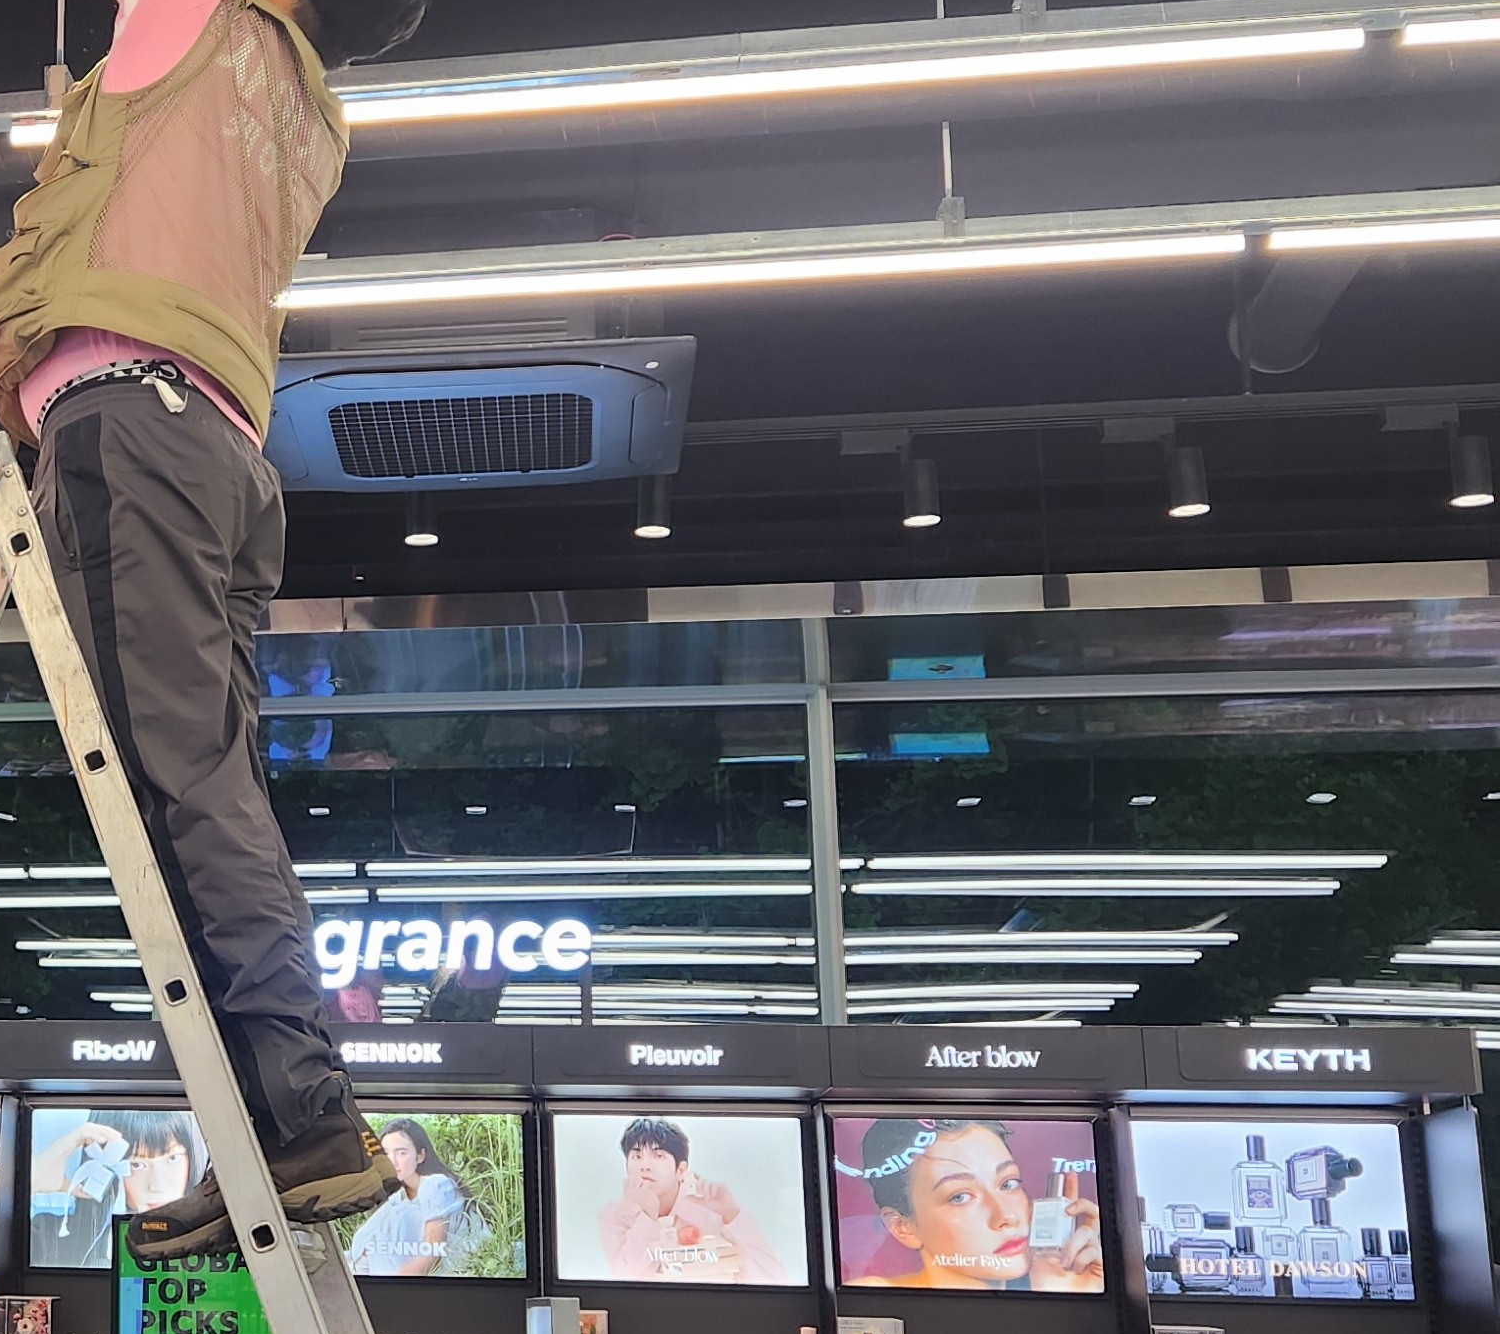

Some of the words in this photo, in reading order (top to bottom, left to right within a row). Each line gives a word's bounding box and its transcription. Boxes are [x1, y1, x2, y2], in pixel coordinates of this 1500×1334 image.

[315, 918, 592, 990] grance
[72, 1040, 157, 1063] RboW
[341, 1042, 443, 1063] SENNOK
[629, 1044, 724, 1067] Pleuvoir
[925, 1045, 982, 1068] After
[984, 1045, 1041, 1068] blow
[1247, 1048, 1371, 1071] KEYTH
[364, 1240, 447, 1259] SENNOK
[932, 1253, 978, 1268] Atelier
[980, 1254, 1012, 1269] Faye
[134, 1253, 251, 1274] GLOBA
[1179, 1257, 1262, 1276] HOTEL
[1269, 1259, 1368, 1279] DAWSON
[134, 1277, 208, 1305] TOP
